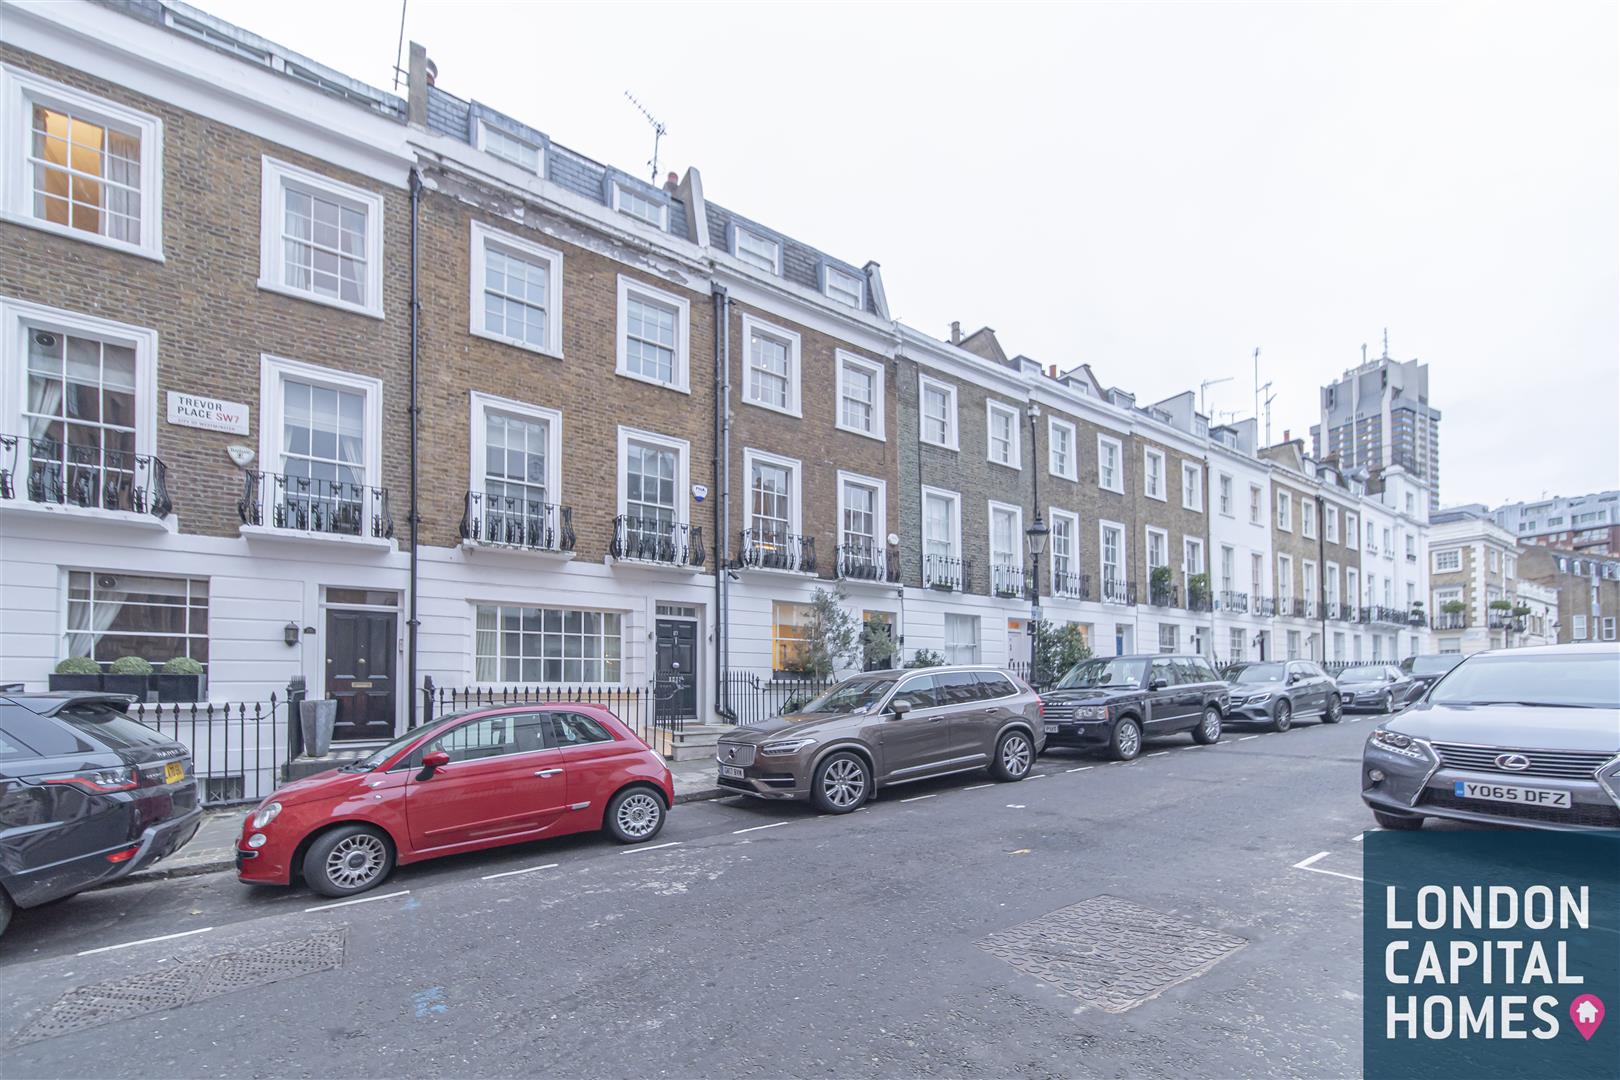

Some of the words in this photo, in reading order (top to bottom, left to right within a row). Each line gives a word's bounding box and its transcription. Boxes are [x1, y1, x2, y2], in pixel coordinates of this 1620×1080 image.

[178, 396, 223, 412] TREVOR
[177, 405, 213, 420] PLACE
[215, 412, 240, 424] SW7
[1467, 784, 1518, 800] YO65
[1524, 790, 1566, 806] DFZ
